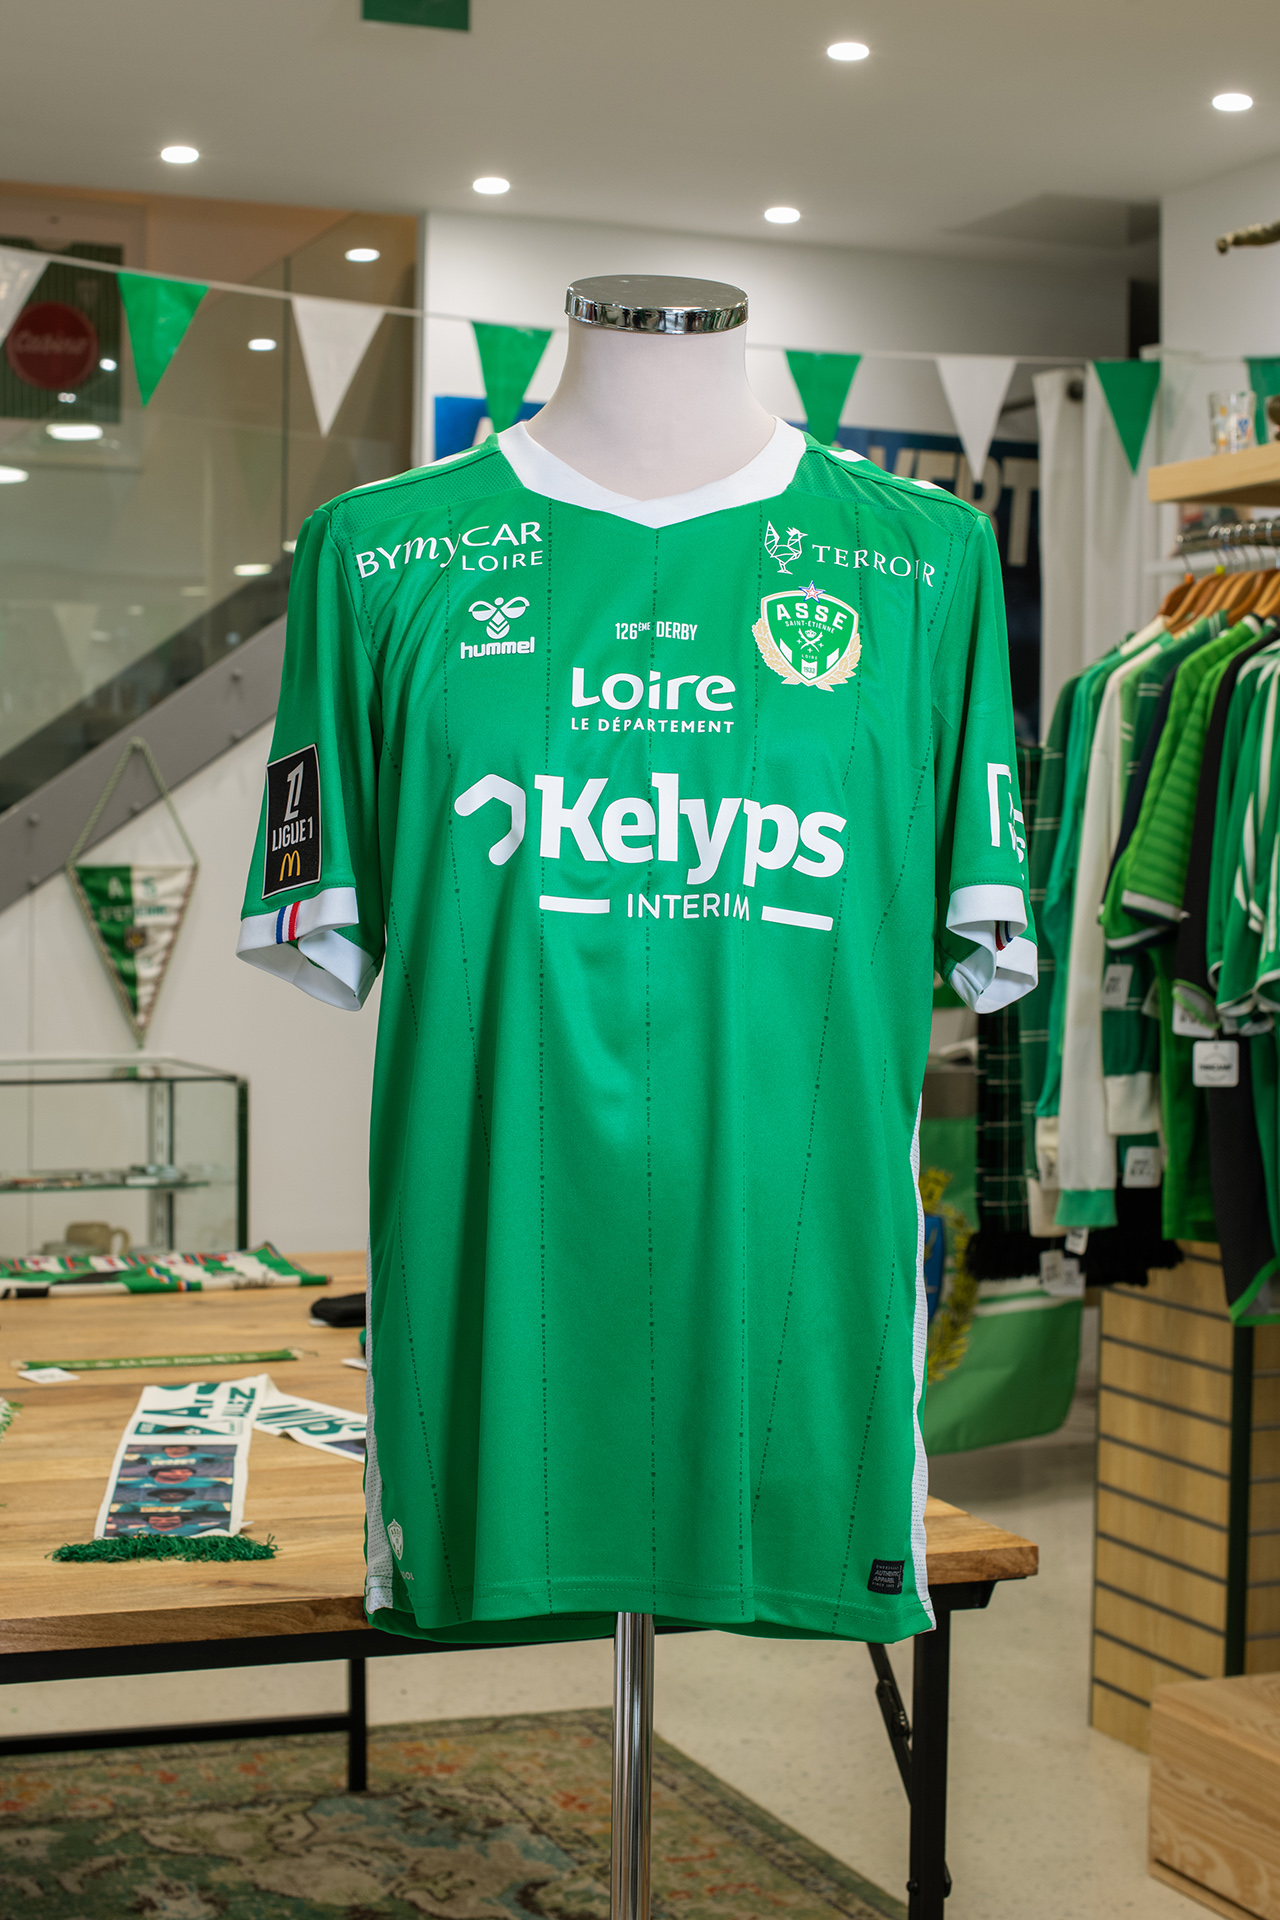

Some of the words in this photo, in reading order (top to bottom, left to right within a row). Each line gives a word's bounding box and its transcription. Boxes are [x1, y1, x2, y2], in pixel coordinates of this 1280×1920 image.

[355, 521, 543, 579] BYmyCAR
[462, 550, 544, 572] LOIRE
[812, 544, 936, 588] TERROIR
[656, 620, 698, 641] DERBY
[776, 602, 848, 630] ASSE
[460, 636, 536, 660] hummel
[571, 666, 736, 712] Loire
[571, 717, 589, 730] LE
[598, 716, 735, 734] DÉPARTEMENT
[534, 771, 848, 888] Kelyps
[626, 892, 750, 922] INTERIM
